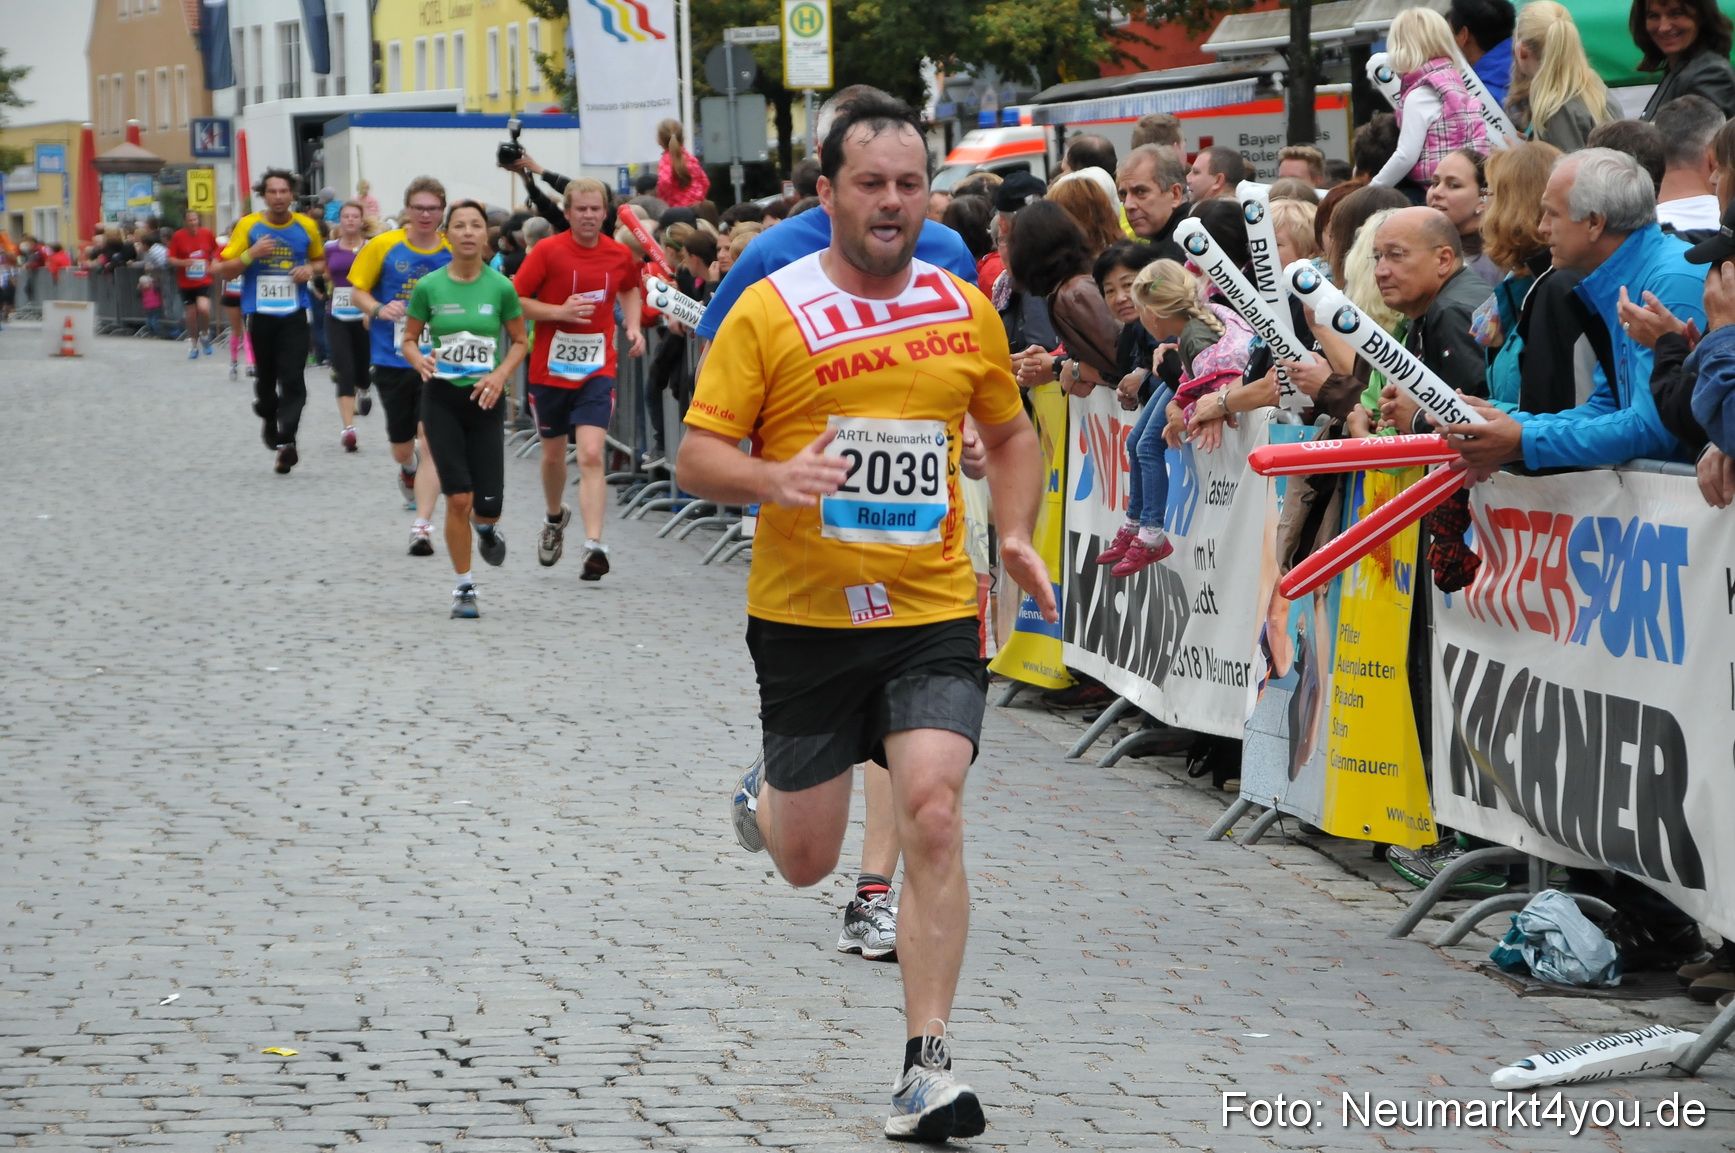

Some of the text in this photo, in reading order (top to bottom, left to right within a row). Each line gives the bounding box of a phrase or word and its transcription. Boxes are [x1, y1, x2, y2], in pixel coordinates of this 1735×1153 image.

[195, 182, 209, 202] D
[1251, 237, 1278, 294] BMW
[261, 284, 292, 298] 3411
[672, 303, 700, 326] BMW
[441, 344, 494, 364] 2046
[555, 344, 600, 362] 2337
[814, 329, 981, 387] MAX BÖGL
[1361, 330, 1417, 382] BMW
[692, 399, 735, 421] oegl.de
[876, 431, 932, 445] Neumarkt
[837, 447, 940, 497] 2039
[857, 506, 917, 527] Roland
